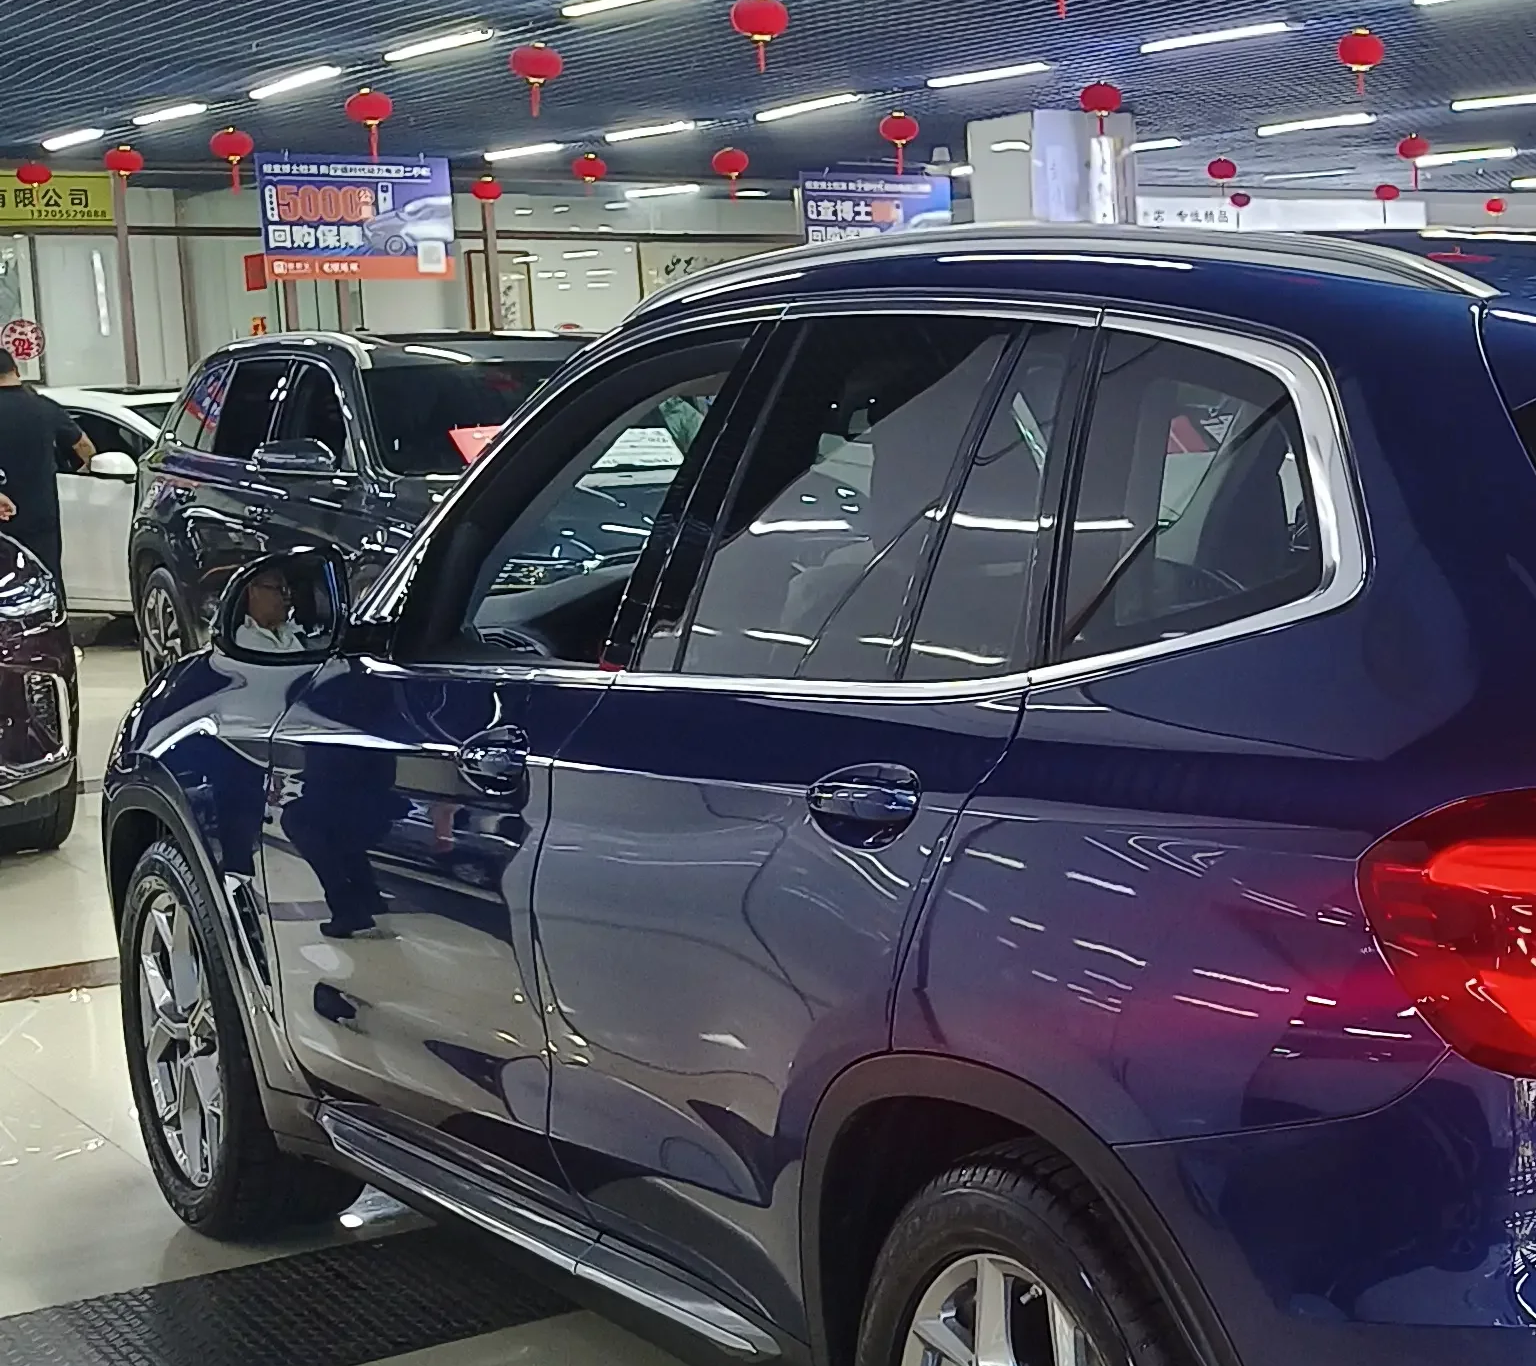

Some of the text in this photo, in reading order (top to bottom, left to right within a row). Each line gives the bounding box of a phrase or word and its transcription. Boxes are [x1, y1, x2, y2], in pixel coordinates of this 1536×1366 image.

[277, 184, 359, 222] 5000
[268, 225, 364, 248] 回购保障
